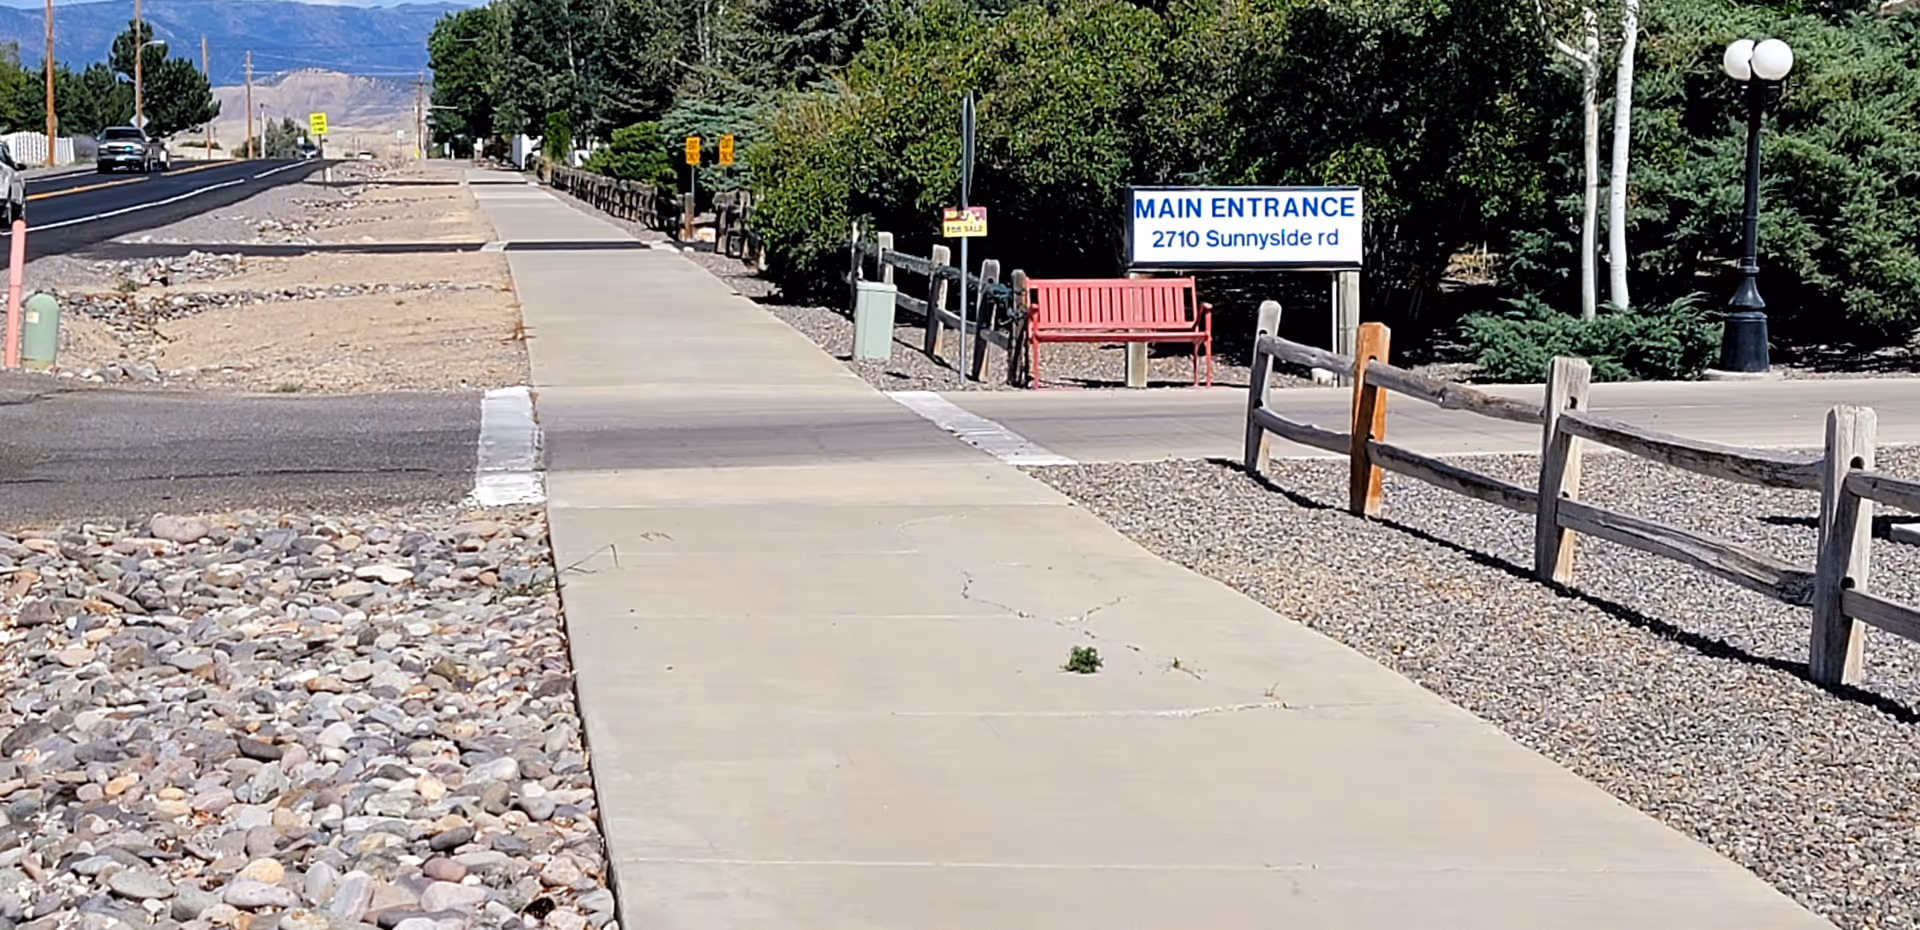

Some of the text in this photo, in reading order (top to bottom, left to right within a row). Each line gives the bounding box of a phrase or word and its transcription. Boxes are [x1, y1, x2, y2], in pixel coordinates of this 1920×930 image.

[1135, 197, 1355, 219] MAIN ENTRANCE
[1152, 229, 1339, 250] 2710 Sunnyside rd
